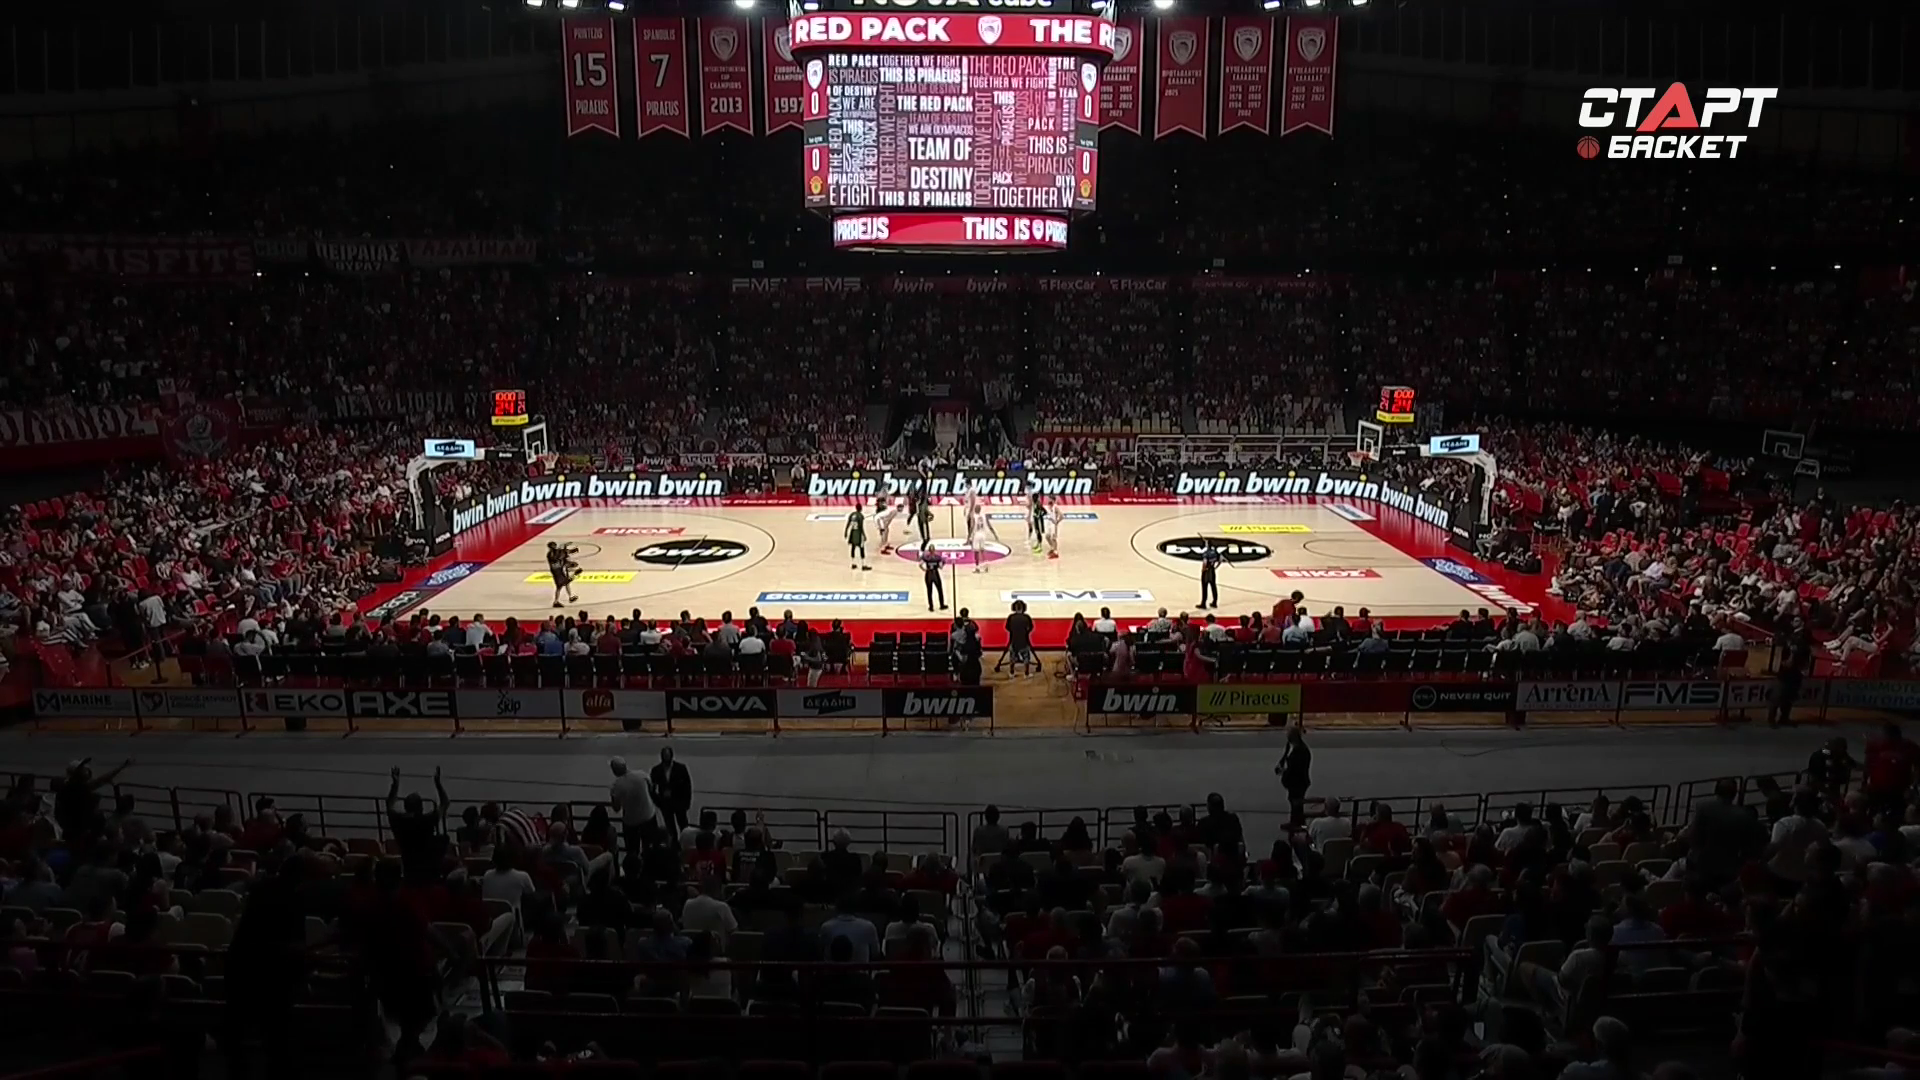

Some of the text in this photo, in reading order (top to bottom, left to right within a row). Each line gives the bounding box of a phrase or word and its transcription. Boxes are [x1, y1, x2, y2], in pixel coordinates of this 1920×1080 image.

[796, 16, 951, 42] RED PACK
[1028, 18, 1092, 45] THE
[573, 52, 607, 87] 15
[828, 54, 879, 67] RED PACK
[880, 55, 960, 67] TOGETHER WE FIGHT
[969, 56, 991, 75] THE
[993, 56, 1016, 76] RED
[1018, 56, 1048, 76] PACK
[1057, 57, 1076, 70] THE
[650, 53, 670, 87] 7
[840, 69, 879, 84] PIRAEUS
[879, 67, 961, 83] THIS IS PIRAEUS
[710, 81, 742, 90] CHAMPIONS
[844, 85, 877, 96] DESTINY
[969, 76, 1048, 89] TOGETHER WE FIGHT
[575, 99, 609, 115] PIRAEUS
[711, 97, 743, 113] 2013
[811, 91, 819, 114] 0
[859, 97, 875, 110] ARE
[897, 95, 973, 112] THE RED PACK
[993, 91, 1015, 105] THIS
[1084, 94, 1093, 118] 0
[646, 100, 679, 116] PIRAEUS
[843, 119, 863, 134] THIS
[1028, 117, 1055, 131] PACK
[908, 137, 973, 160] TEAM OF
[1028, 136, 1068, 154] THIS IS
[812, 148, 820, 171] 0
[1028, 156, 1075, 174] PIRAEUS
[1082, 151, 1091, 174] 0
[910, 167, 973, 190] DESTINY
[992, 171, 1013, 184] PACK
[840, 185, 877, 206] FIGHT
[879, 191, 972, 206] THIS IS PIRAEUS
[992, 187, 1058, 207] TOGETHER
[962, 217, 1031, 240] THIS IS
[314, 240, 399, 262] ΠΕΙΡΑΙΑΣ
[805, 277, 861, 292] FMS
[892, 277, 935, 293] bwin
[966, 277, 1008, 293] bwin
[521, 474, 582, 504] bwin
[588, 472, 650, 497] bwin
[658, 472, 722, 497] bwin
[808, 471, 875, 495] bwin
[953, 471, 1019, 495] bwin
[1025, 470, 1092, 495] bwin
[1177, 470, 1240, 494] bwin
[1246, 470, 1310, 494] bwin
[1315, 472, 1379, 500] bwin
[487, 484, 518, 518] bwin
[1381, 482, 1414, 514] bwin
[453, 500, 484, 534] bwin
[1415, 495, 1449, 530] bwin
[435, 531, 451, 544] NOVA
[1453, 526, 1469, 539] NOVA
[635, 545, 744, 557] bwin
[1166, 543, 1267, 555] bwin
[765, 591, 898, 601] Stoiximan
[61, 694, 112, 706] MARINE
[275, 694, 343, 711] EKO
[586, 691, 612, 707] alfa
[902, 690, 975, 715] bwin
[1103, 687, 1176, 712] bwin
[1230, 691, 1290, 706] Piraeus
[1440, 692, 1482, 701] NEVER
[1483, 691, 1512, 701] QUIT
[1625, 683, 1720, 704] FMS
[353, 691, 450, 715] AXE
[672, 695, 767, 712] NOVA
